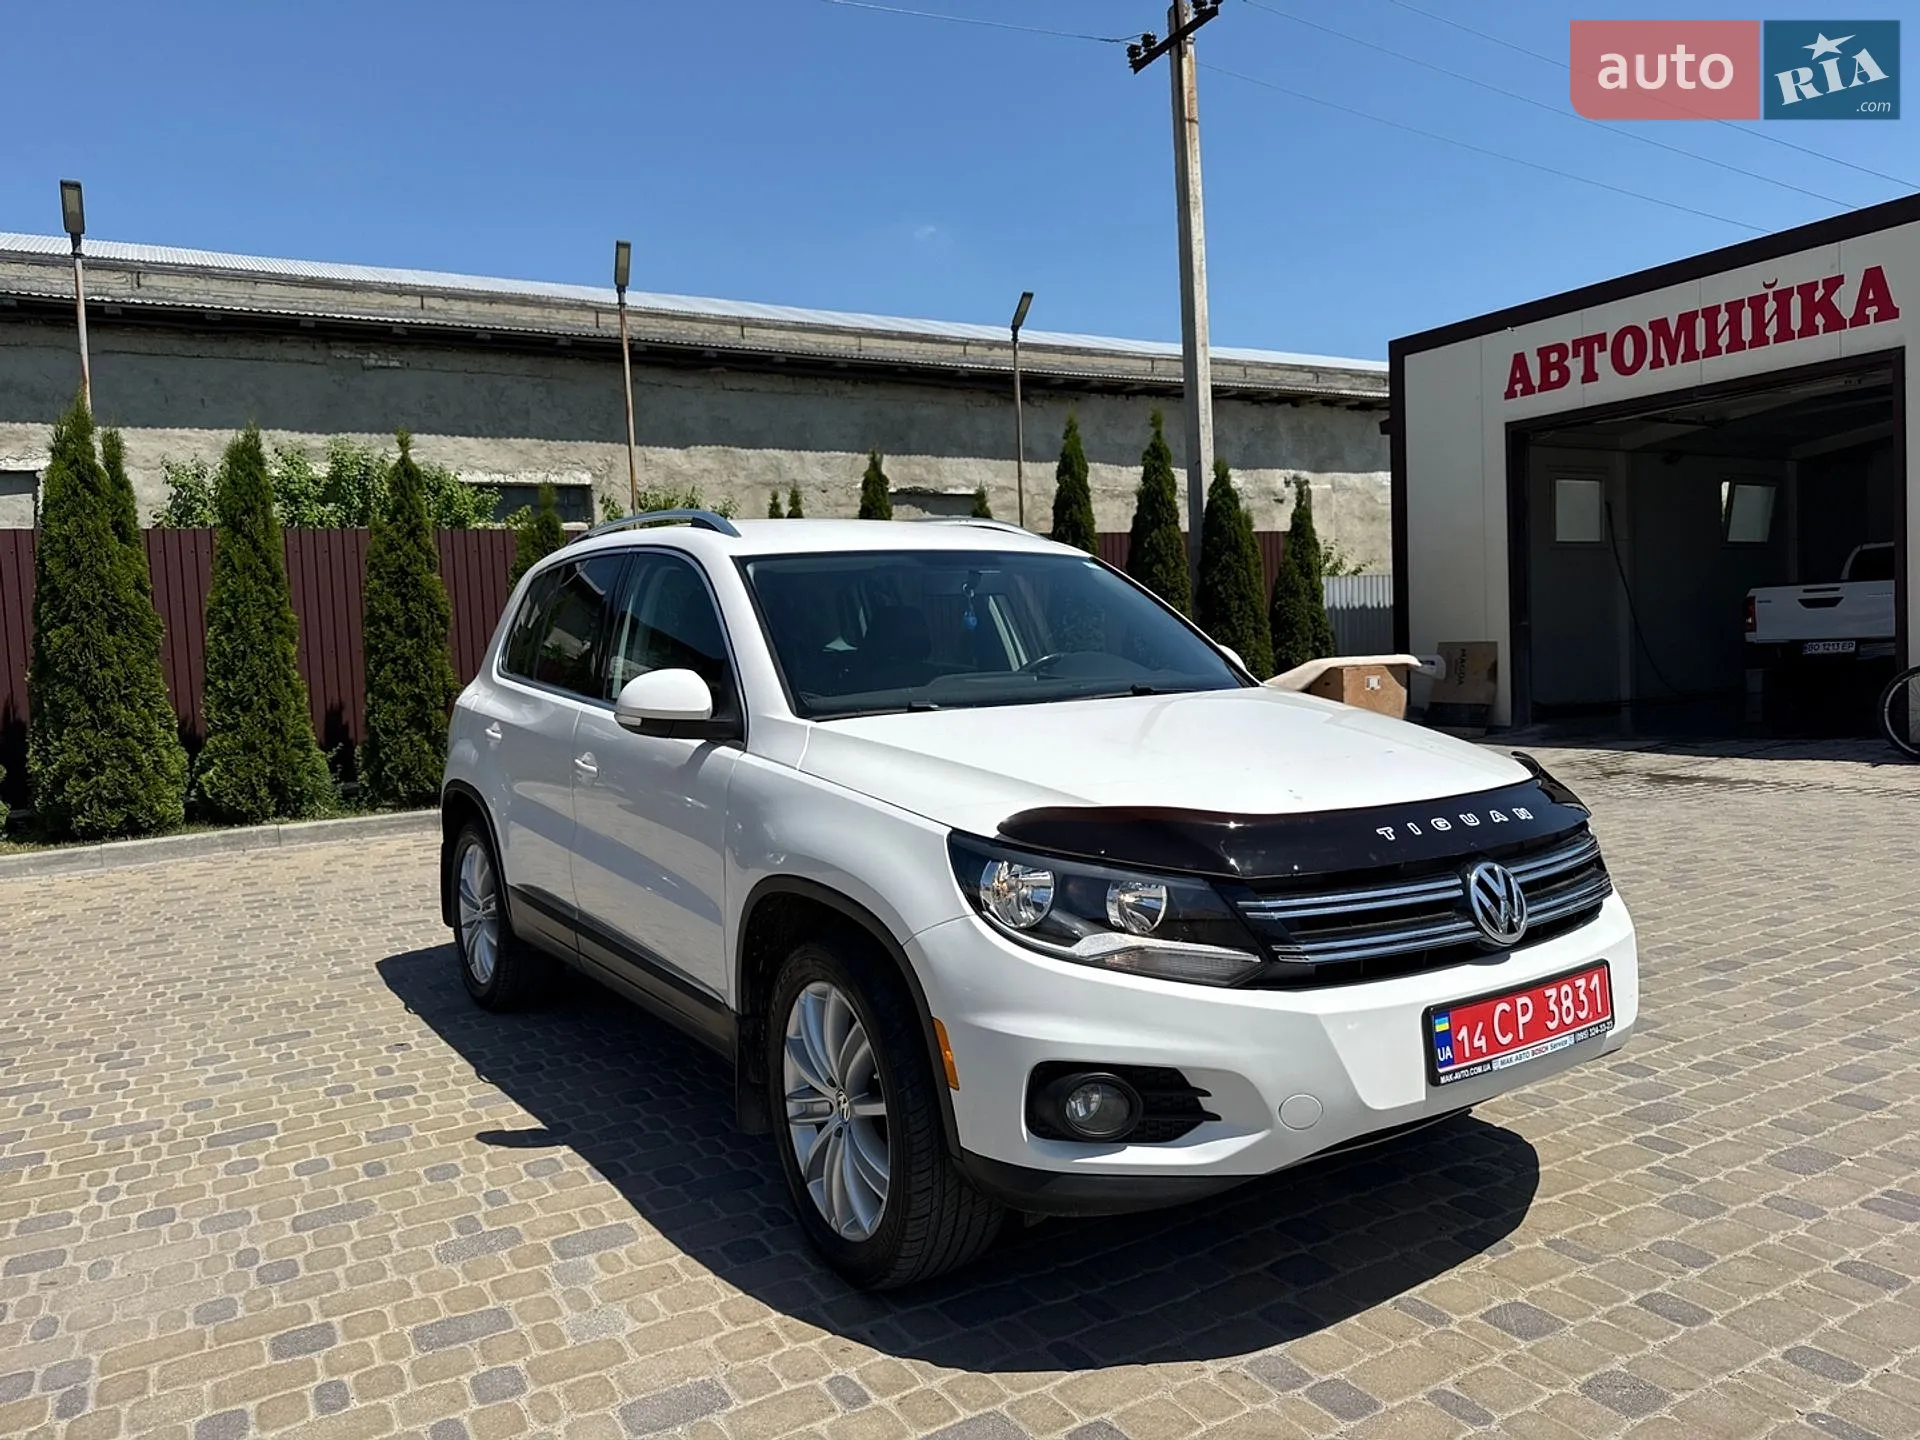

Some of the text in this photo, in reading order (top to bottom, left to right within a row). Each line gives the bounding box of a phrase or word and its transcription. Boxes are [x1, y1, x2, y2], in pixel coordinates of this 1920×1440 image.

[1504, 264, 1900, 400] АВТОМИЙКА
[1376, 807, 1533, 841] TIGUAN
[1456, 973, 1603, 1058] 14 CP 3831
[1437, 1046, 1453, 1061] UA
